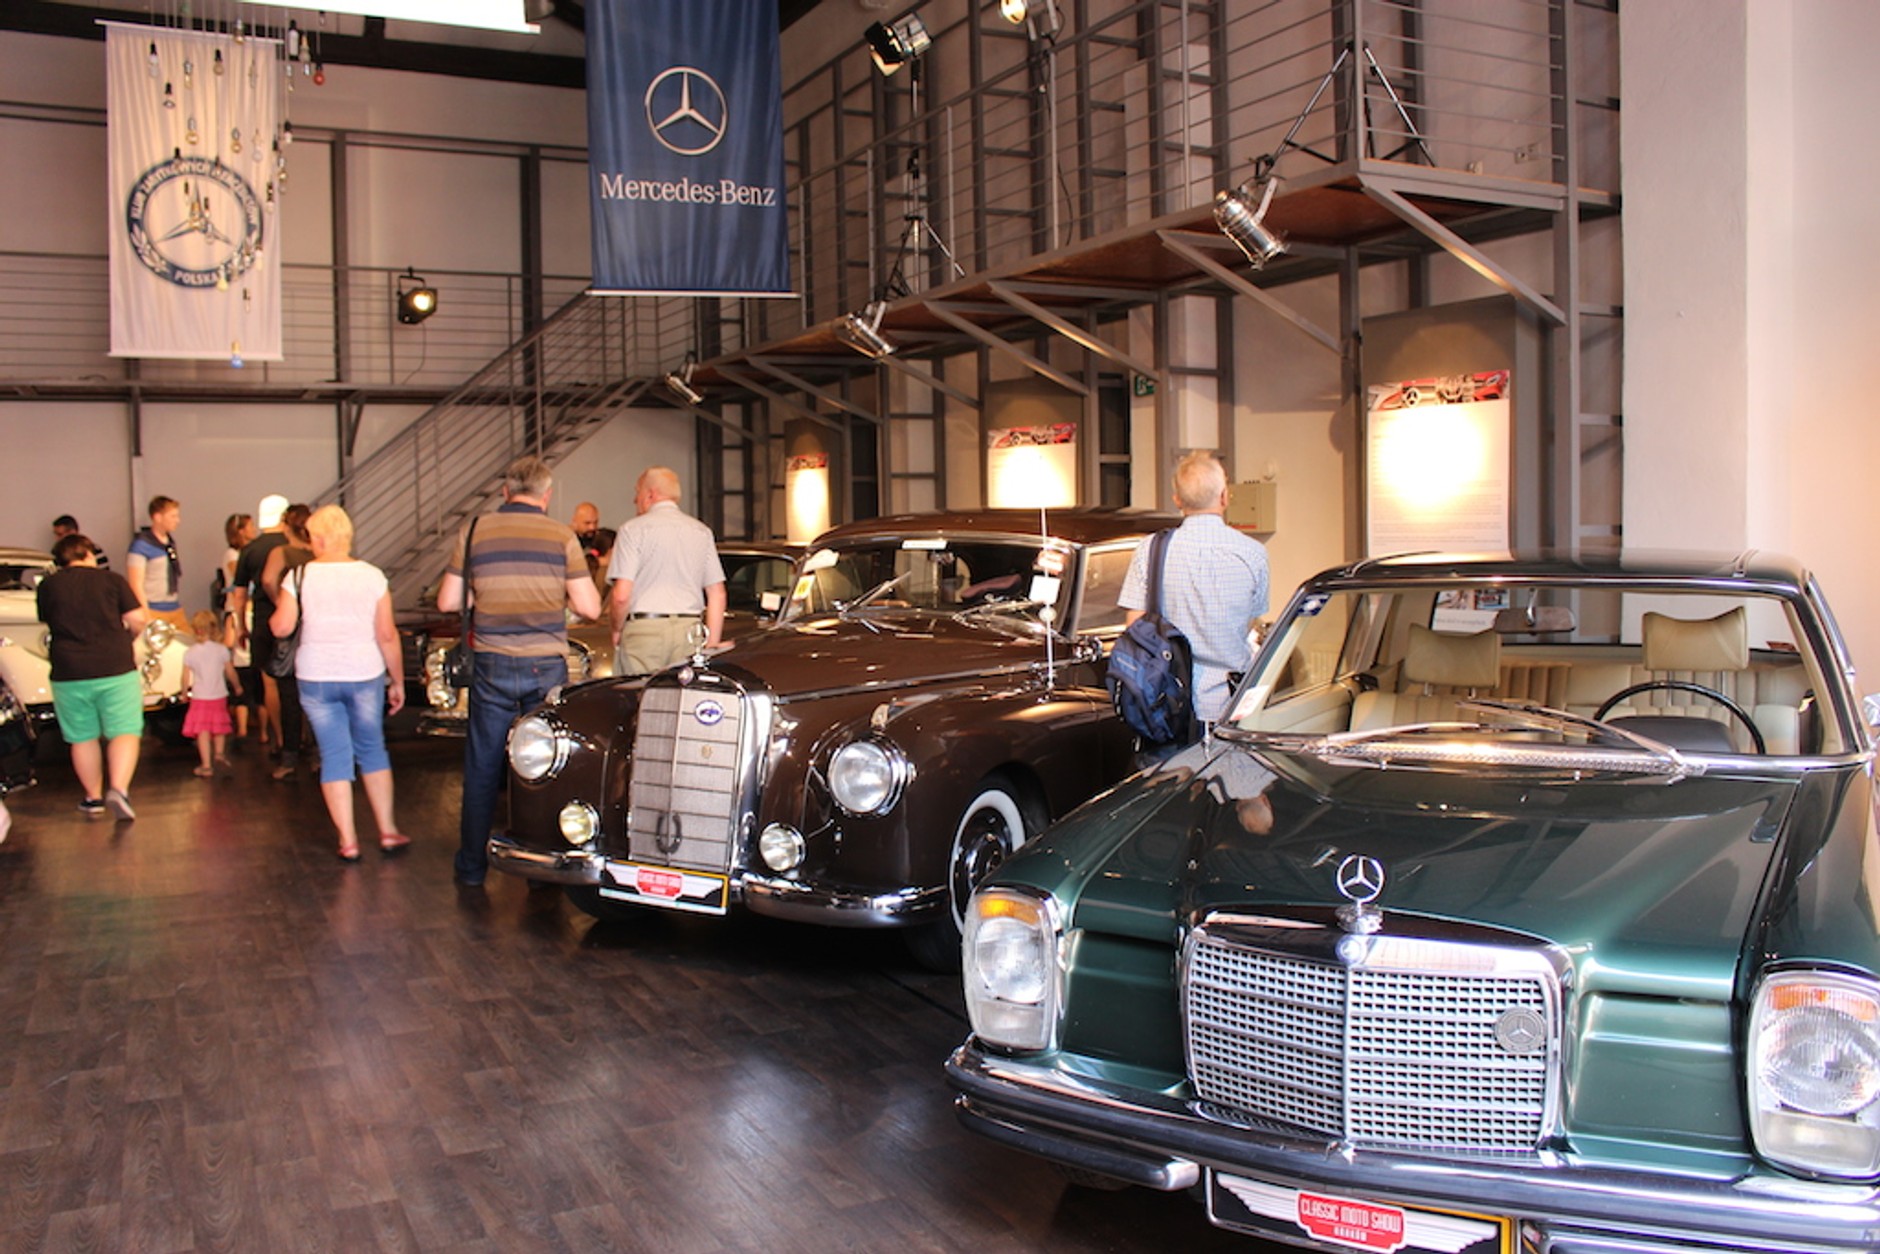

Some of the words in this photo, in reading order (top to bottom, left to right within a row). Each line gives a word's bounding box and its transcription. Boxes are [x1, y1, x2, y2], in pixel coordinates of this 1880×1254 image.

[600, 173, 776, 206] Mercedes-Benz
[175, 270, 219, 285] POLSKA
[1301, 1199, 1339, 1220] CLASSIC
[1341, 1207, 1368, 1226] MOTO
[1372, 1212, 1401, 1232] SHOW
